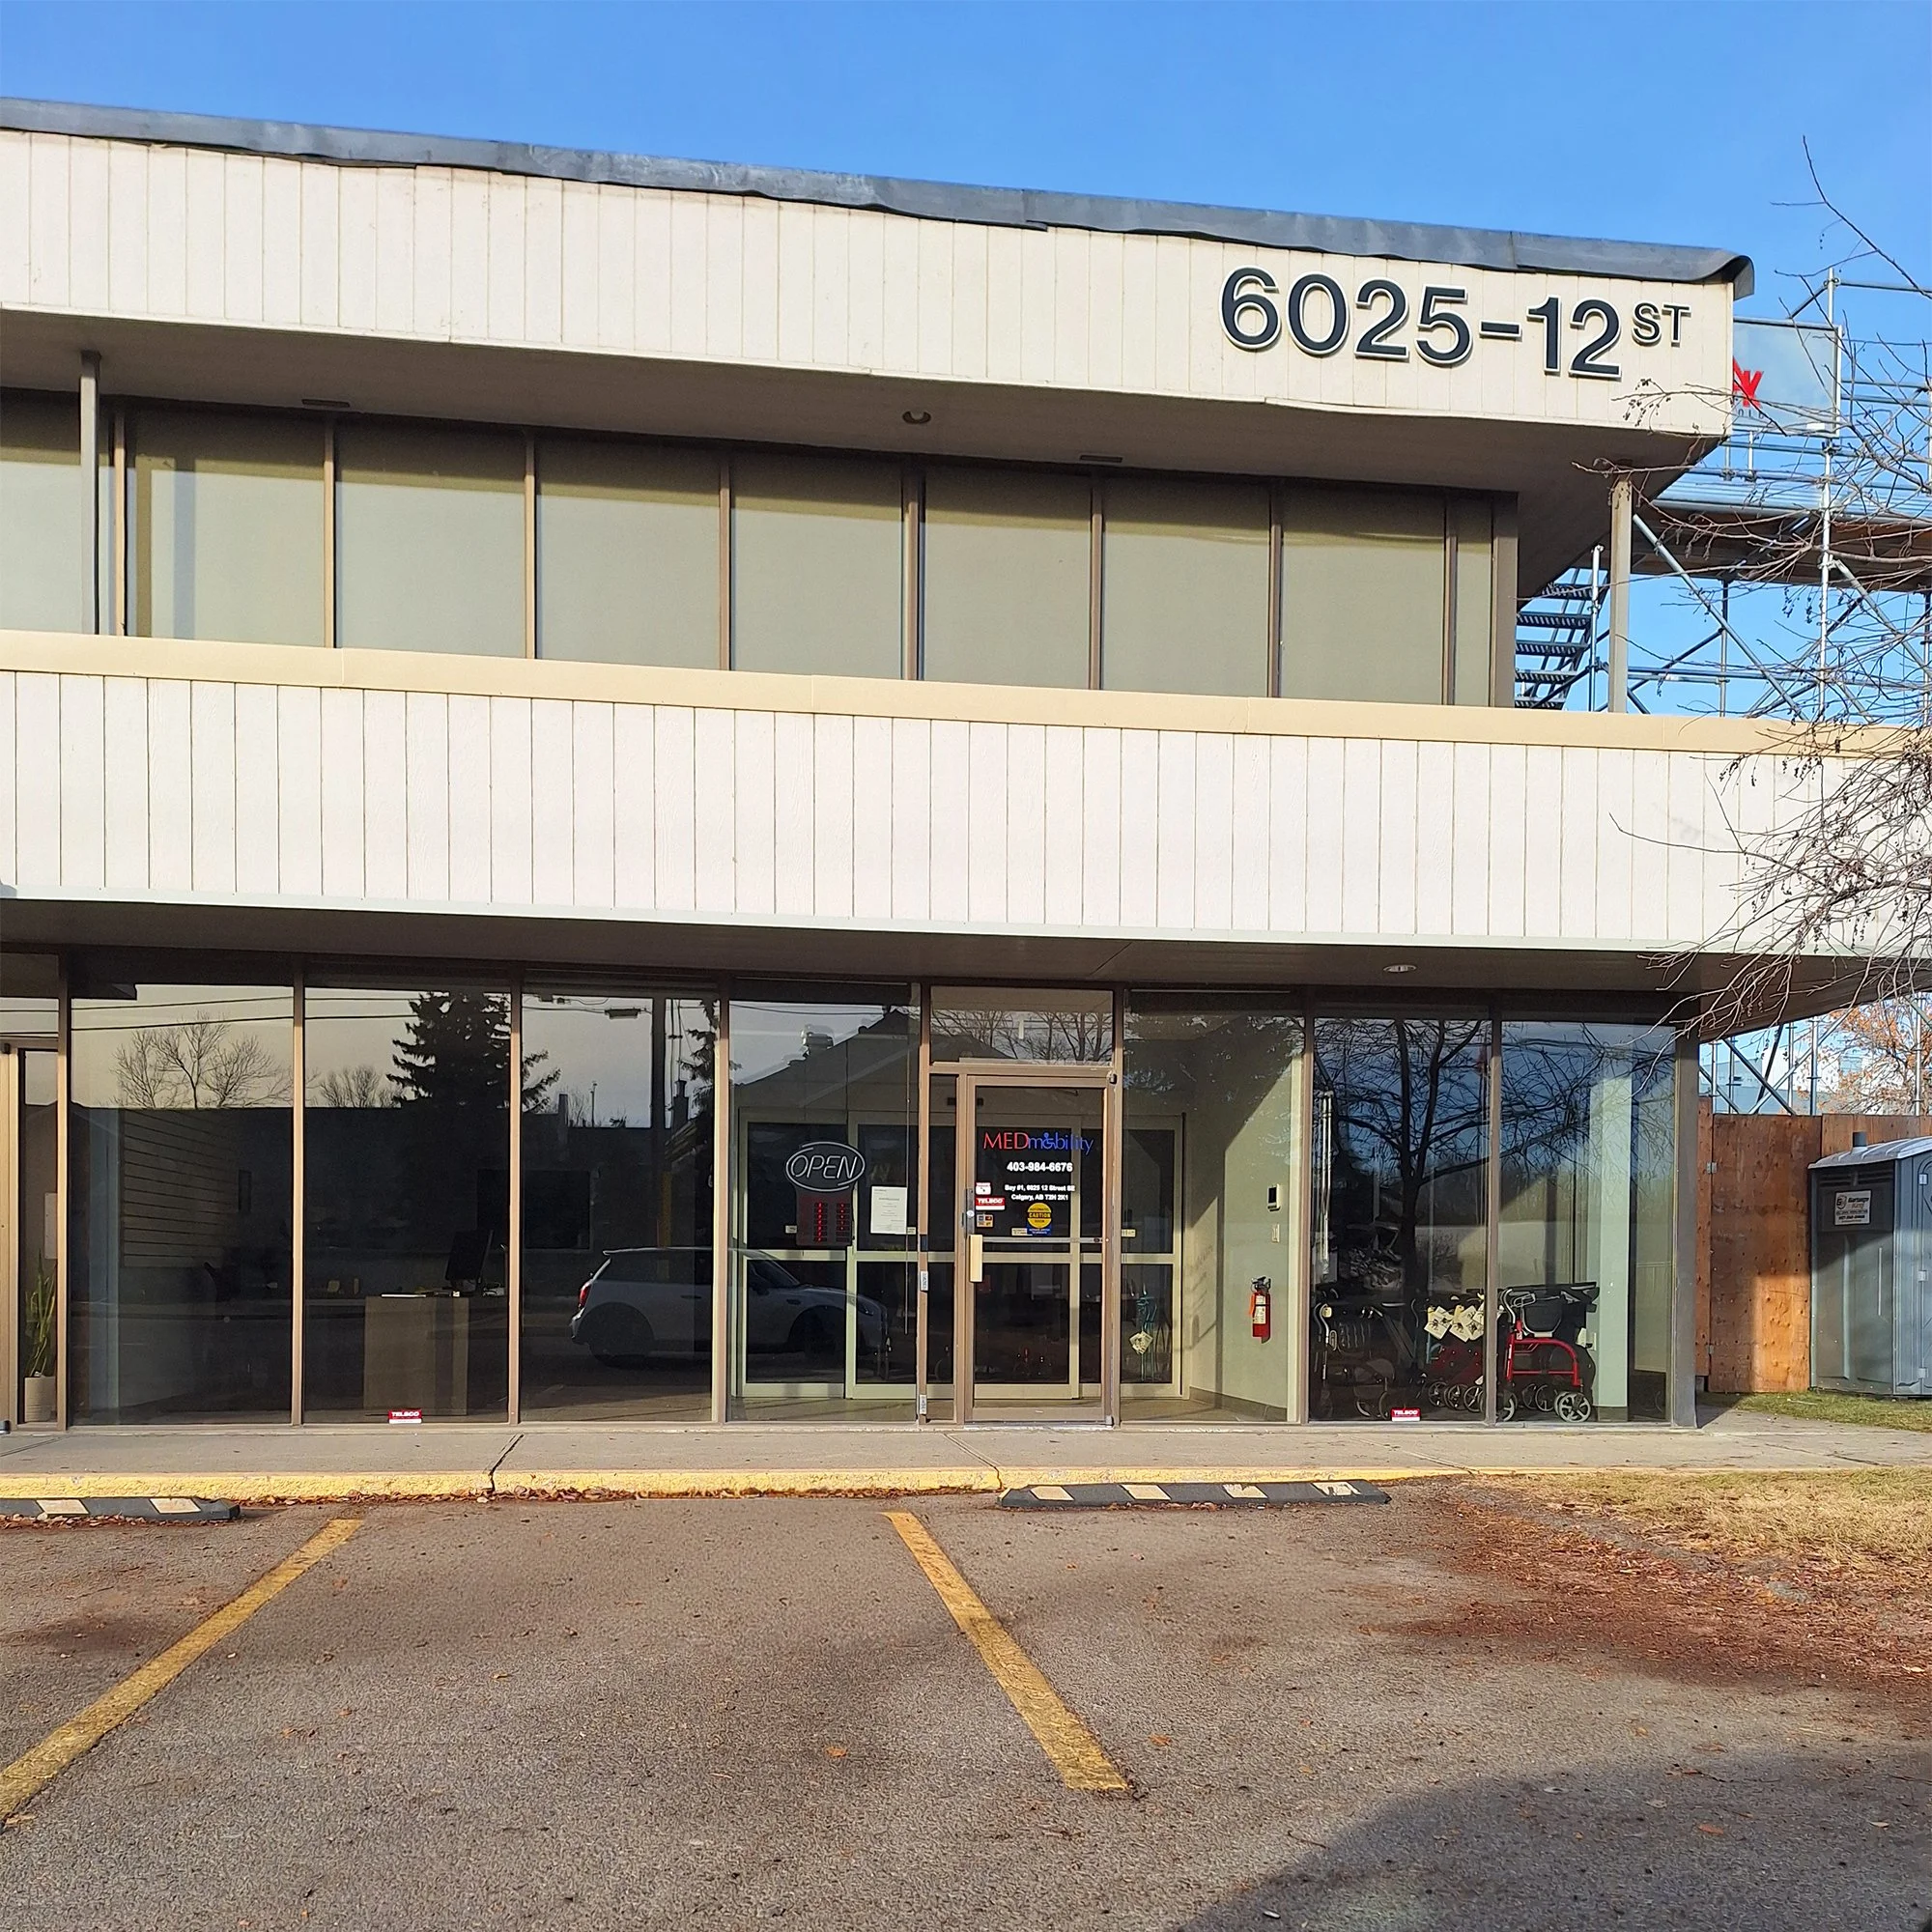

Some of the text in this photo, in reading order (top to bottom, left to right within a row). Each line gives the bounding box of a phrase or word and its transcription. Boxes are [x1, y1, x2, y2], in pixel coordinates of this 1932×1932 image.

[1218, 266, 1691, 381] 6025-12 ST
[790, 1154, 858, 1179] OPEN
[1007, 1161, 1073, 1172] 403-984-6676
